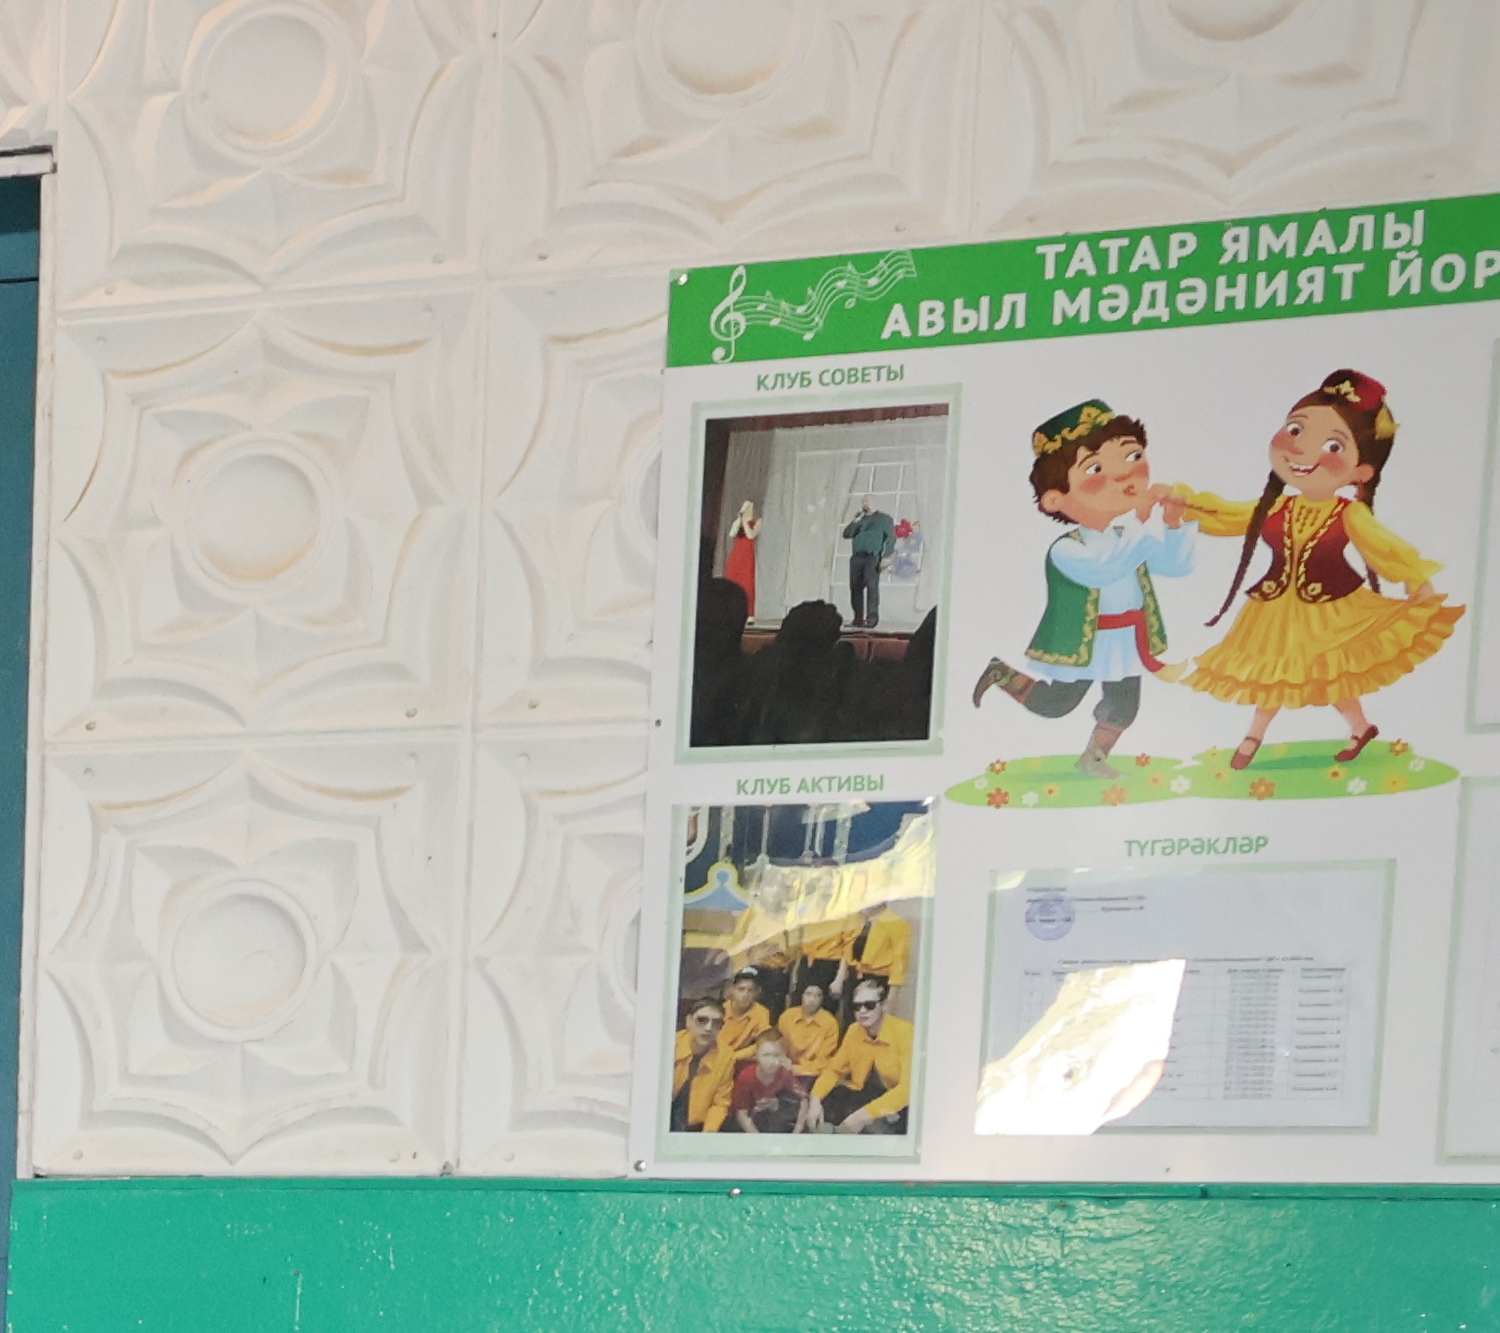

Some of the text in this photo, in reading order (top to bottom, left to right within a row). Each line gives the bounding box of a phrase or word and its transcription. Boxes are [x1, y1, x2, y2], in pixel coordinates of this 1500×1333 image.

[1035, 209, 1426, 281] ТАТАР ЯМАЛЫ
[880, 292, 1027, 340] АВЫЛ
[1052, 262, 1366, 326] МӘДӘНИЯТ
[756, 364, 904, 391] КЛУБ СОВЕТЫ
[736, 774, 884, 797] КЛУБ АКТИВЫ
[1124, 836, 1270, 859] ТҮГӘРӘКЛӘР
